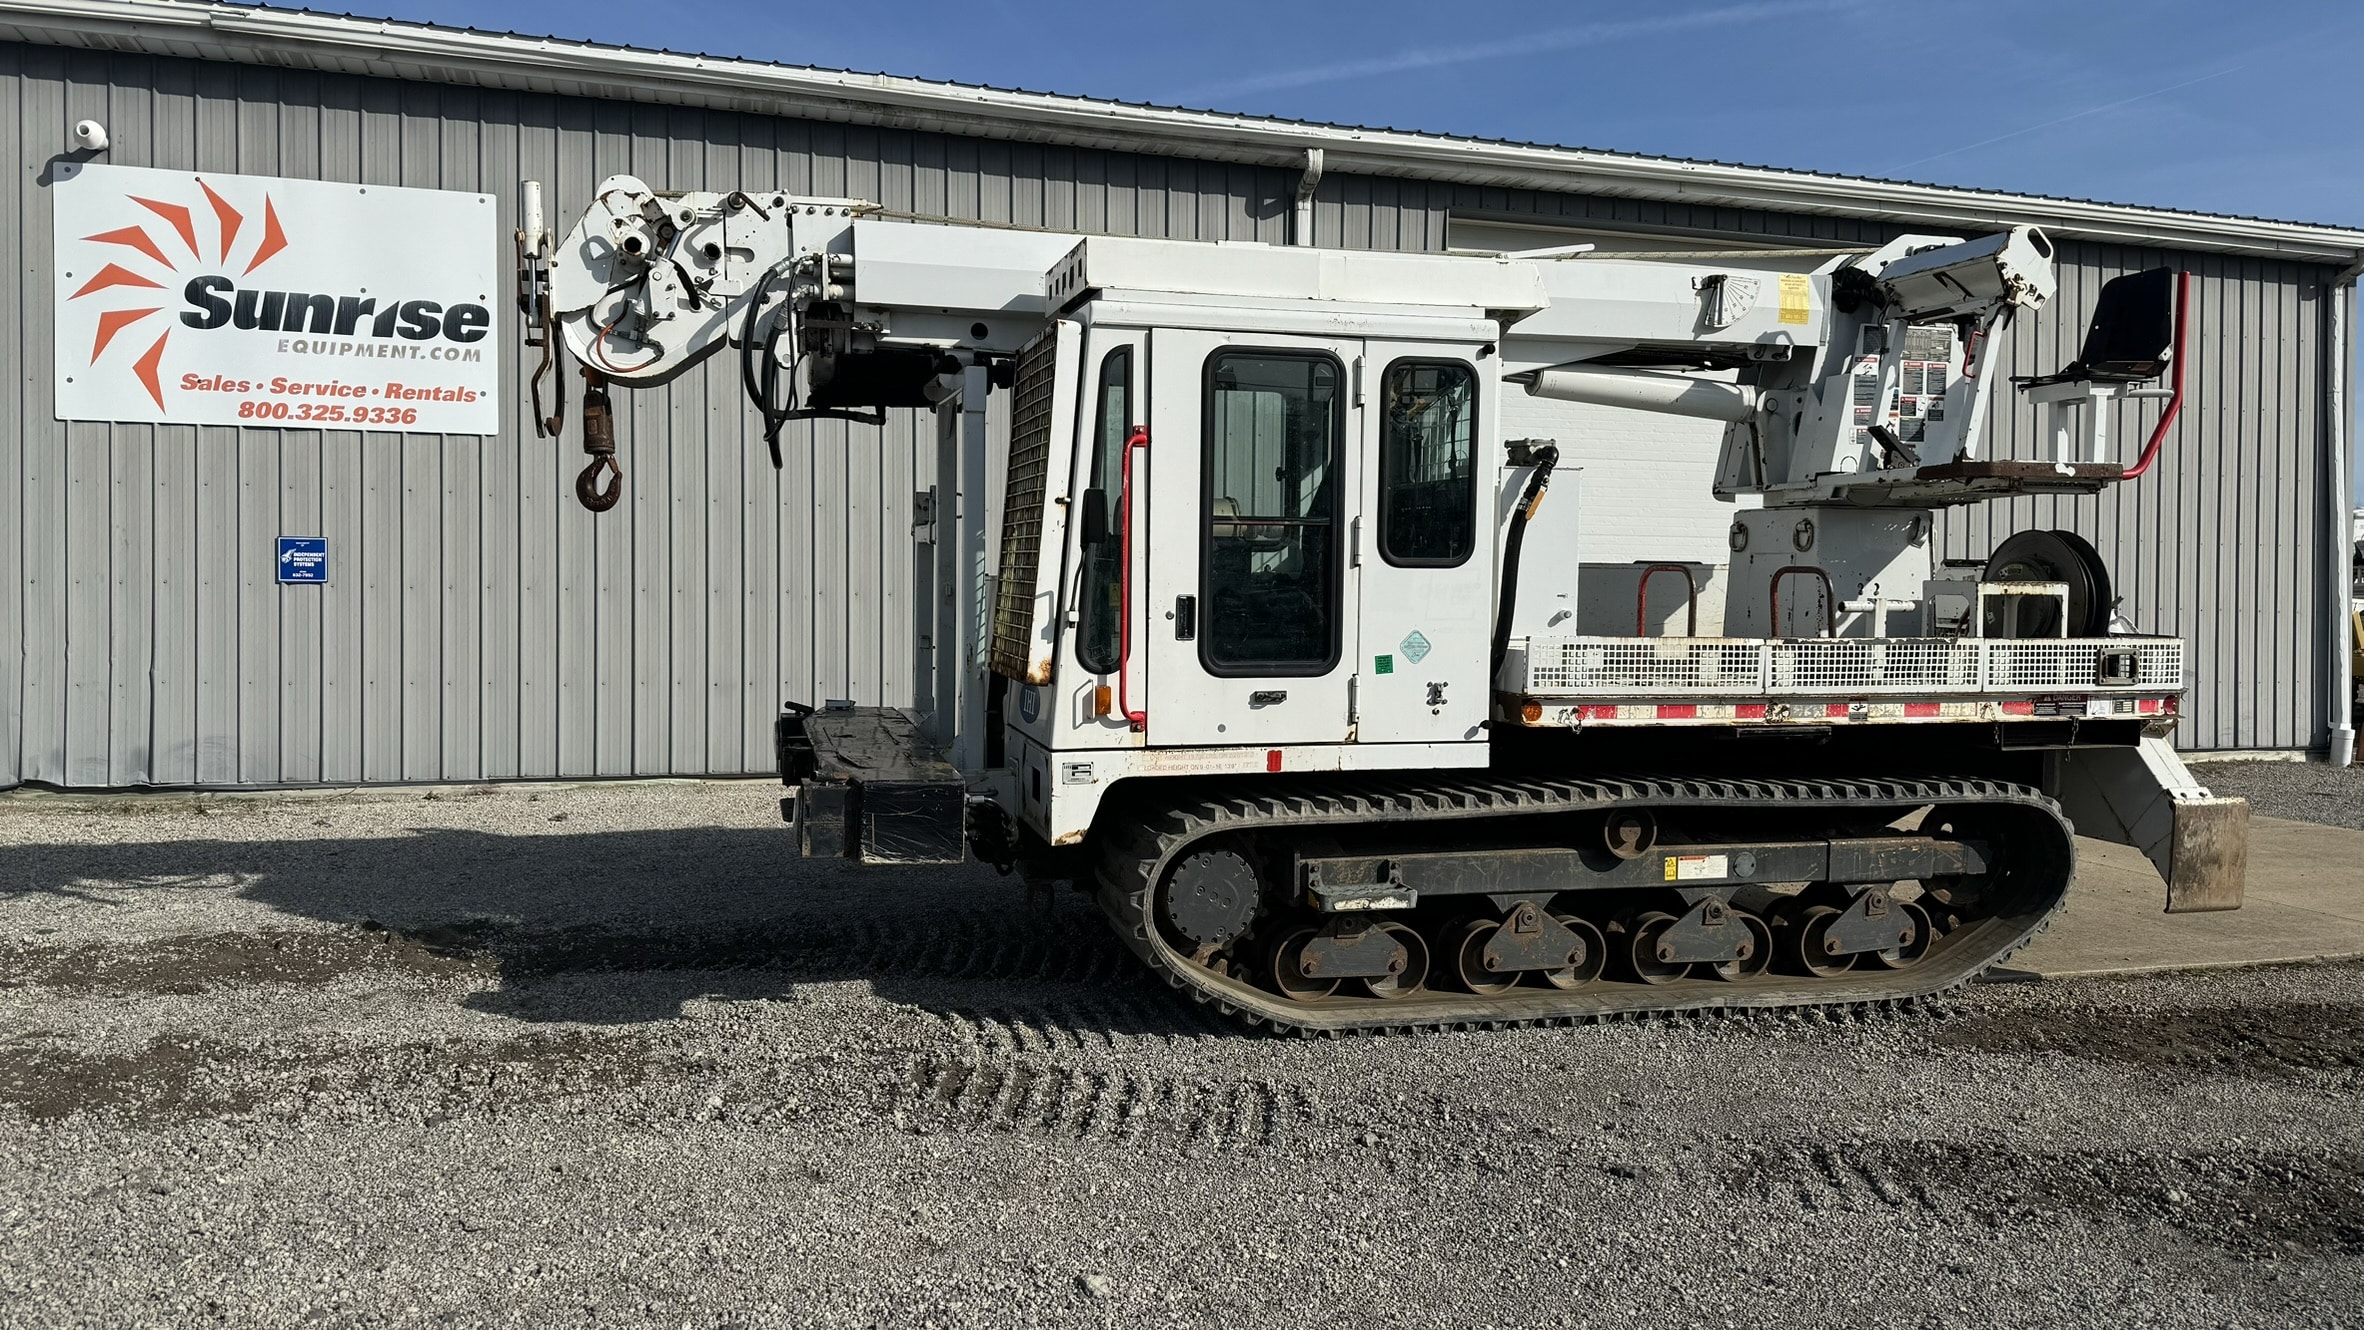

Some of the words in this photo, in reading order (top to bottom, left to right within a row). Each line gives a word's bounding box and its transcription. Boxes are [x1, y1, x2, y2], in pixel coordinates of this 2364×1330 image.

[180, 275, 490, 342] Sunrise
[278, 339, 482, 363] EQUIPMENT.COM
[180, 373, 251, 393] Sales
[270, 377, 366, 399] Service
[385, 382, 478, 403] Rentals
[238, 401, 418, 425] 800.325.9336
[1024, 690, 1036, 714] IHI
